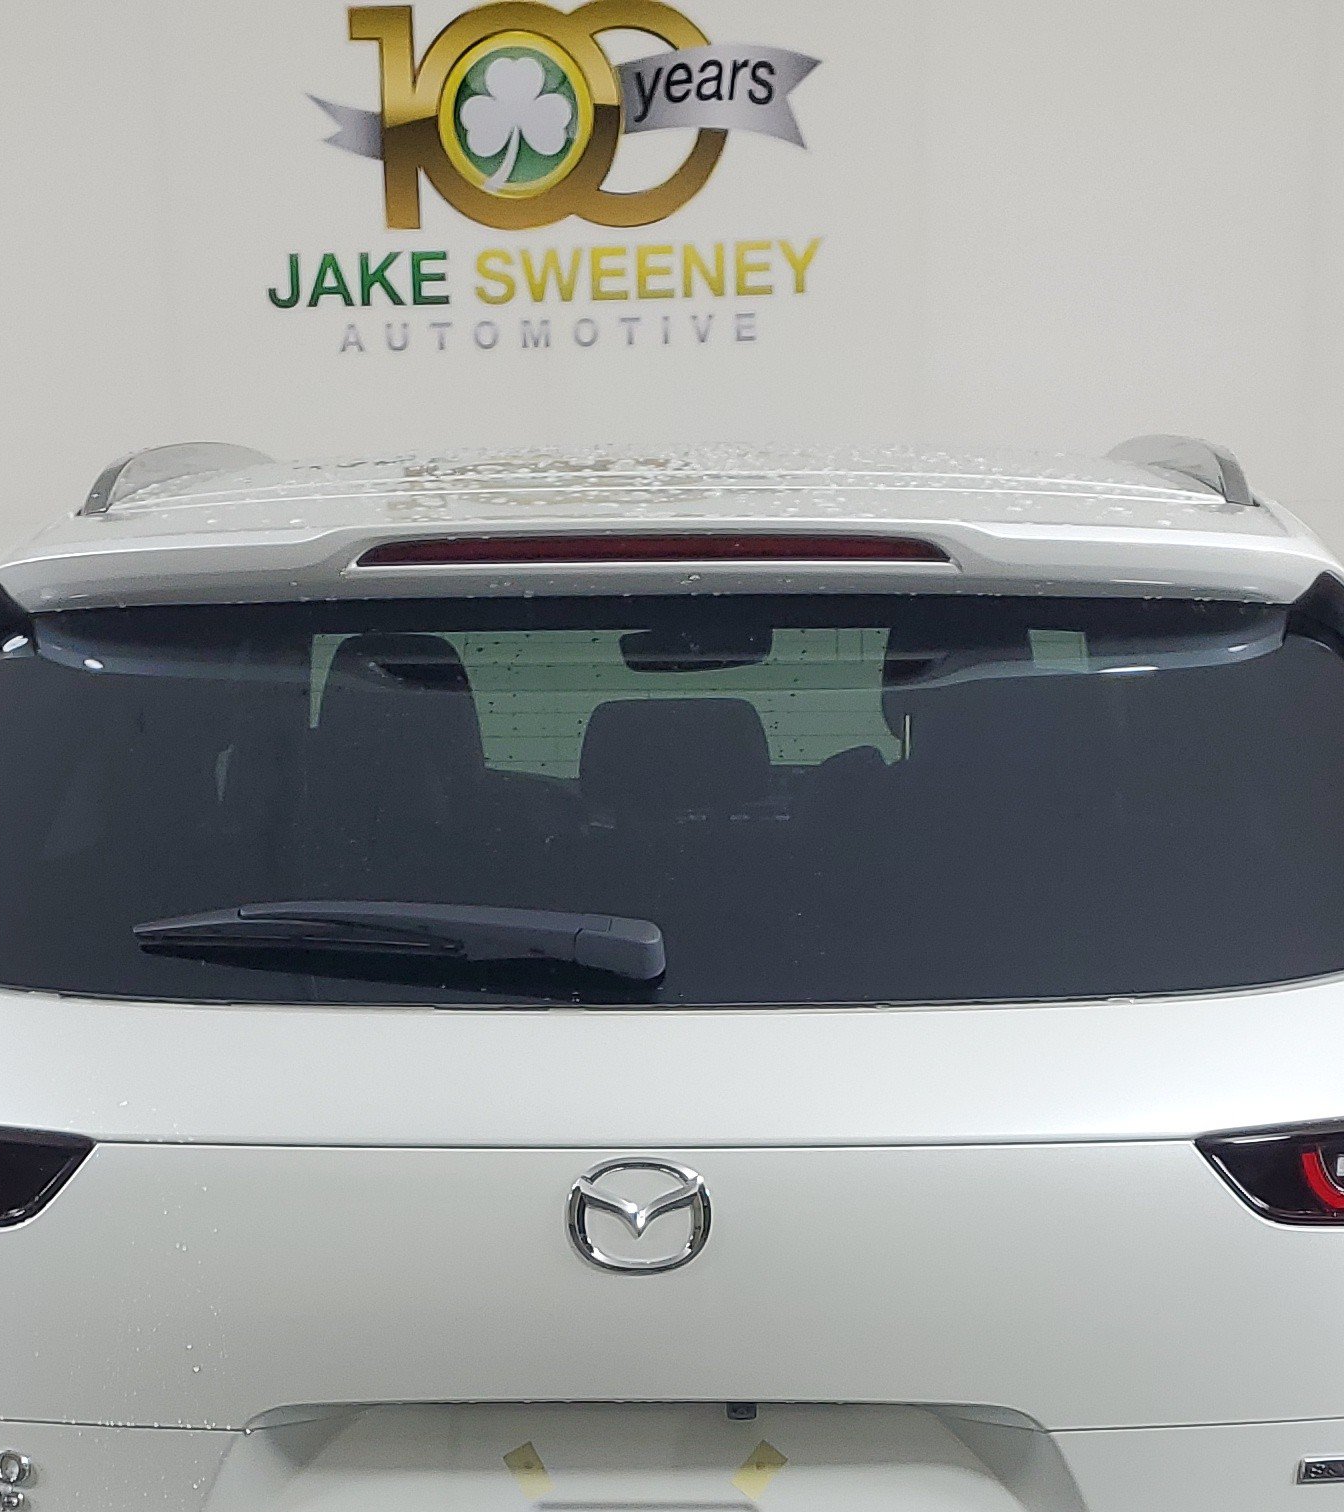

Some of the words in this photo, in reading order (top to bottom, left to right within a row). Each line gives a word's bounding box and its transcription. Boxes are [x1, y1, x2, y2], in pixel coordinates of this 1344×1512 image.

[633, 56, 777, 122] years
[267, 250, 451, 309] JAKE
[473, 236, 824, 306] SWEENEY
[339, 312, 758, 353] AUTOMOTIVE
